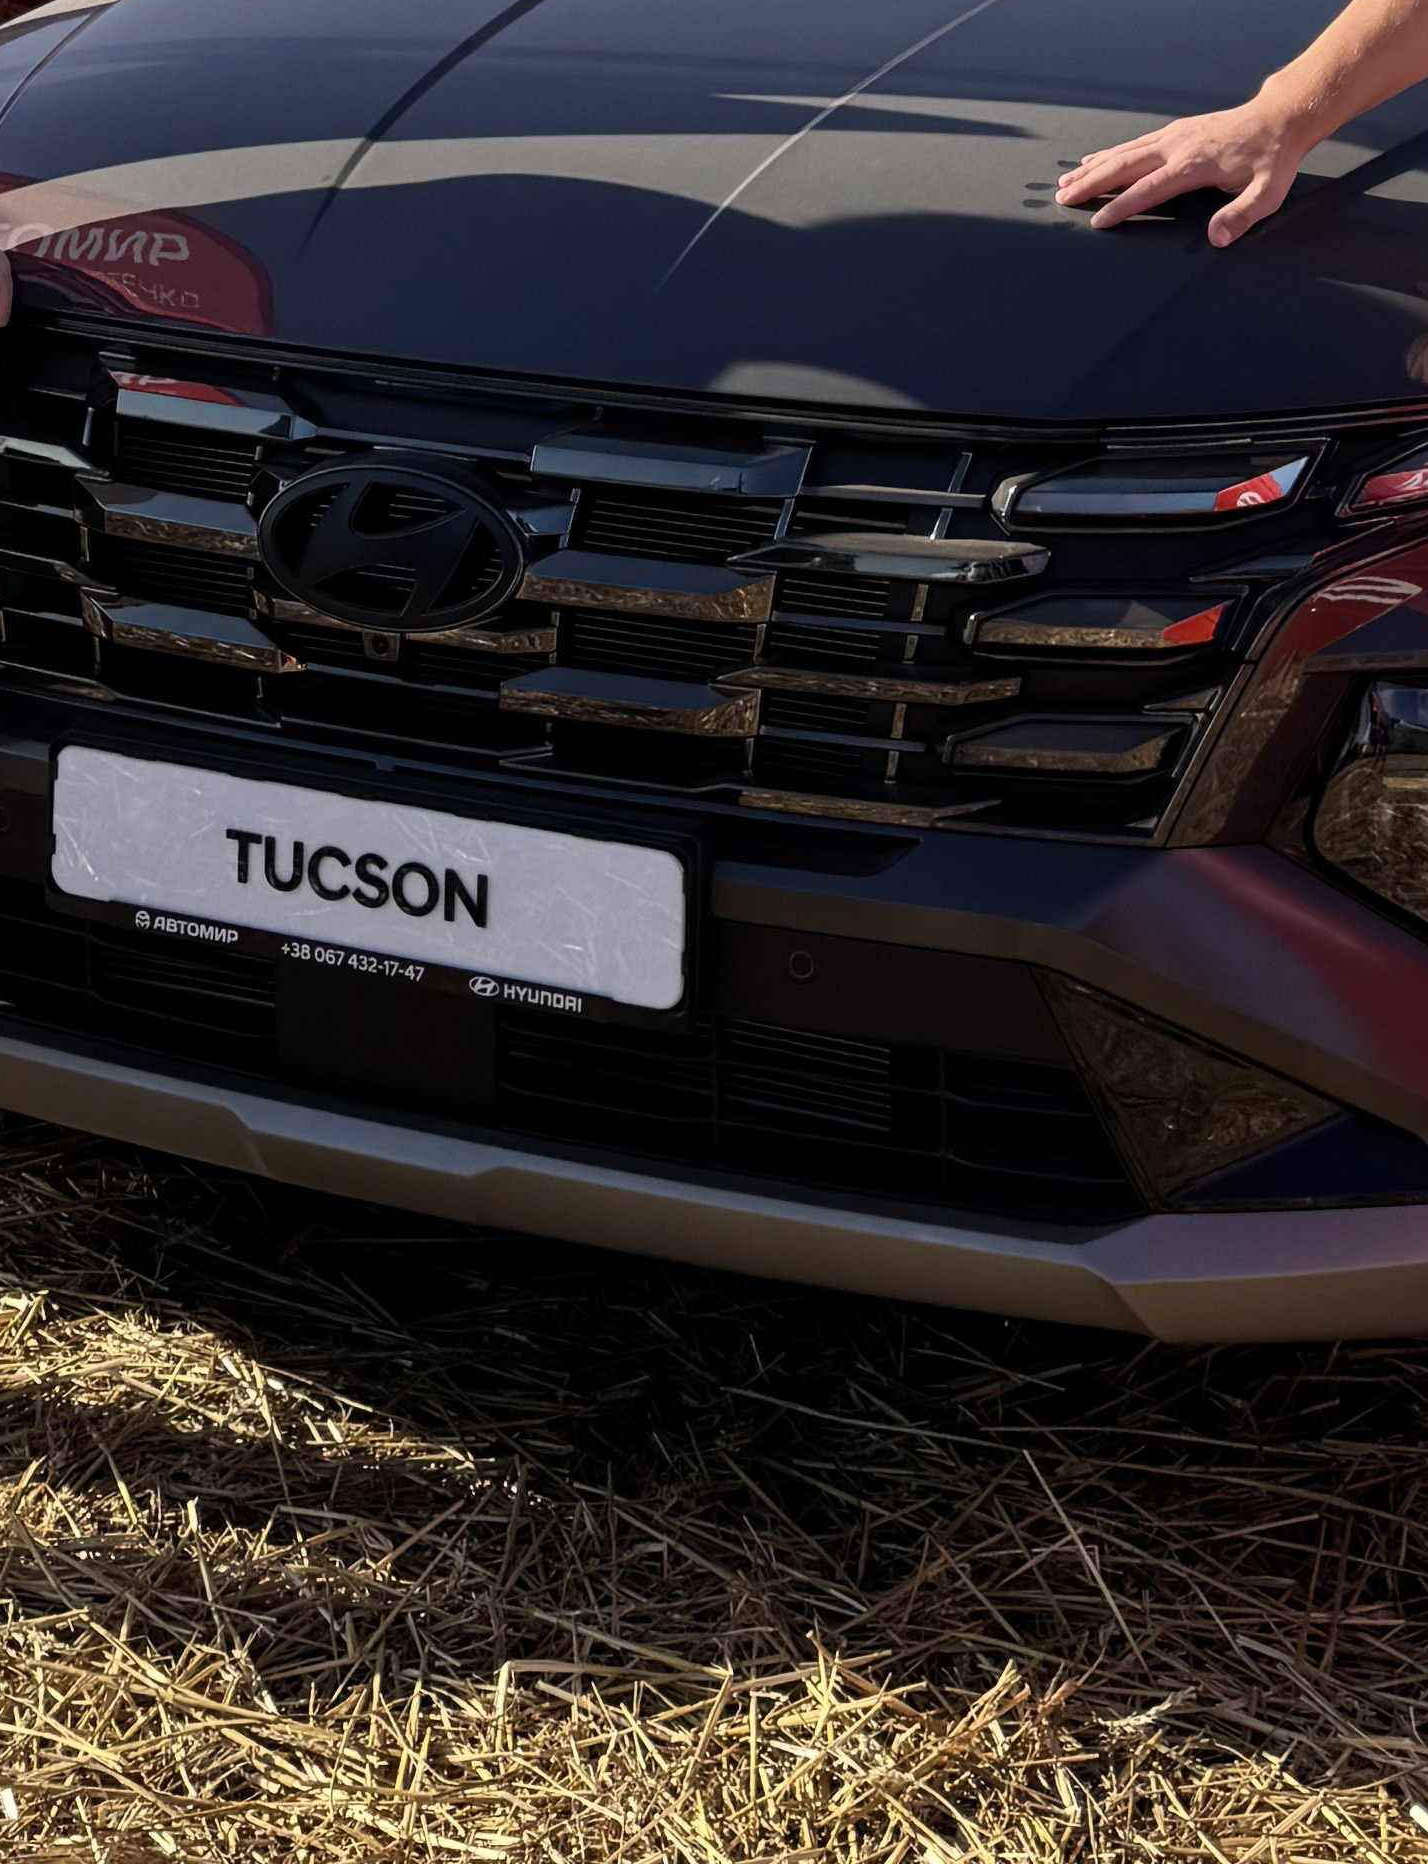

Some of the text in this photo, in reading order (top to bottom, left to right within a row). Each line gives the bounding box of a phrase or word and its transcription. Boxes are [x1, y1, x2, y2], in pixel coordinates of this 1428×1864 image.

[225, 828, 489, 929] TUCSON
[153, 916, 239, 944] АВТОМИР
[280, 942, 425, 982] +38 067 432-17-47
[503, 983, 582, 1013] HYUNDAI
